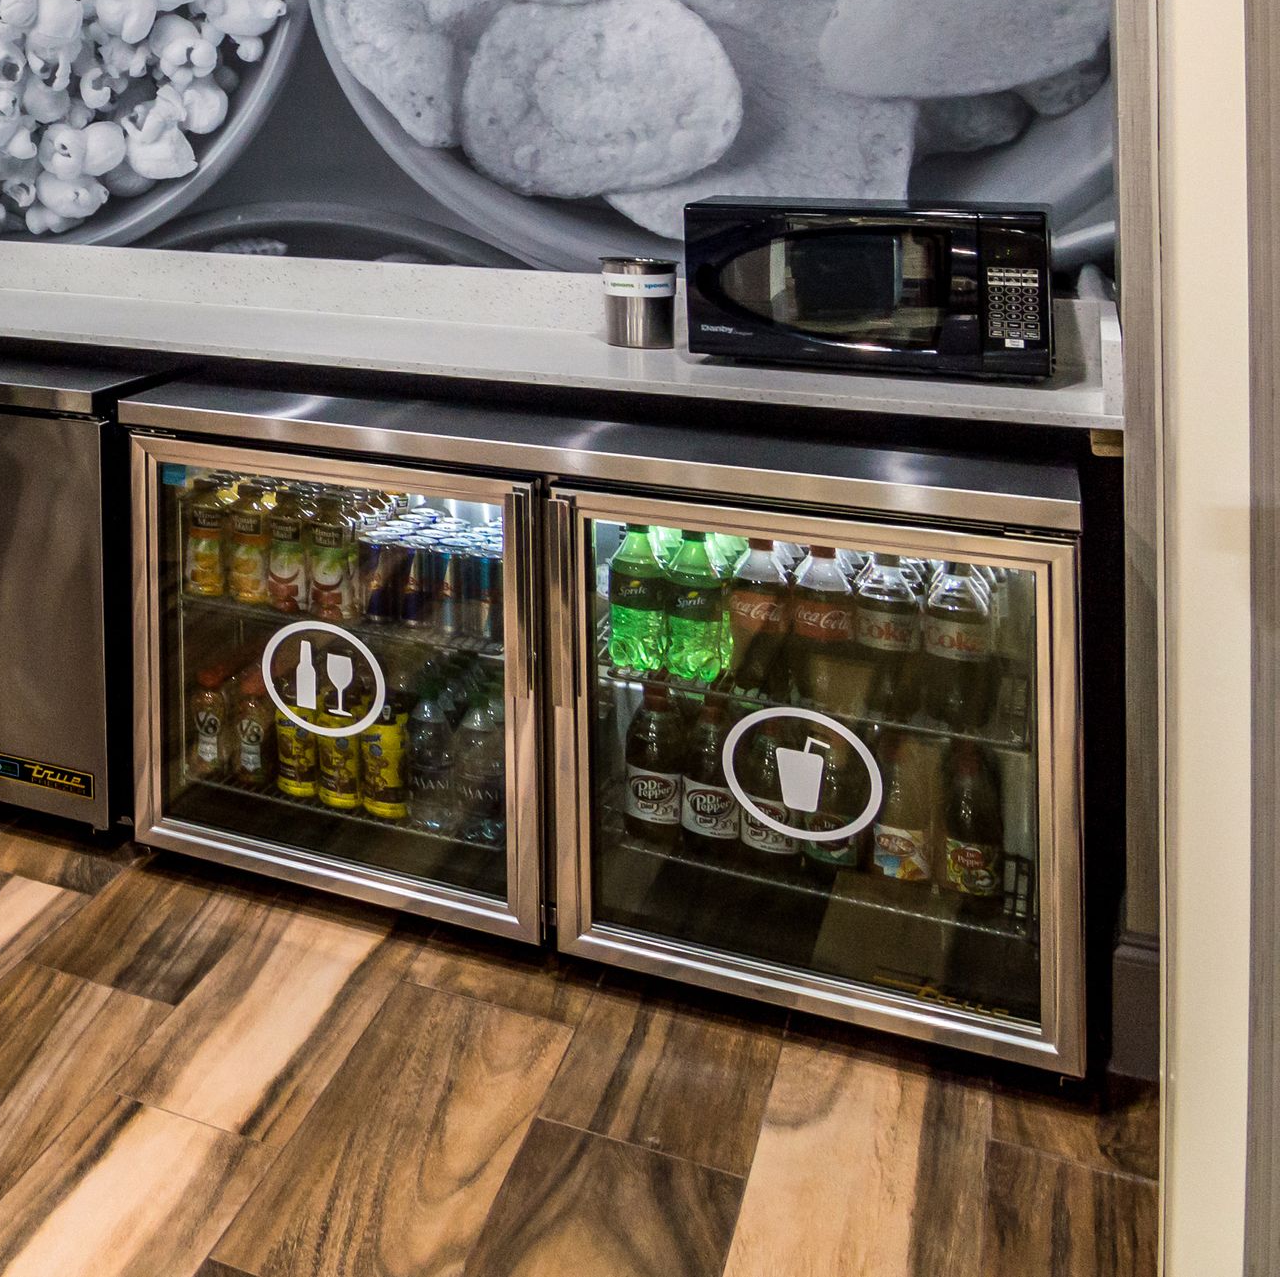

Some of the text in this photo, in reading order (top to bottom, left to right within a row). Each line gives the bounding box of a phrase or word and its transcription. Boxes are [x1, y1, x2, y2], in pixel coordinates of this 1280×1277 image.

[644, 282, 669, 290] spoons
[700, 324, 734, 334] Danby
[619, 586, 648, 597] Sprite
[675, 596, 707, 608] Sprite
[196, 711, 220, 735] V8
[240, 718, 263, 743] V8
[24, 764, 86, 789] true
[638, 779, 672, 800] Dr Pepper
[695, 794, 732, 814] Dr Pepper
